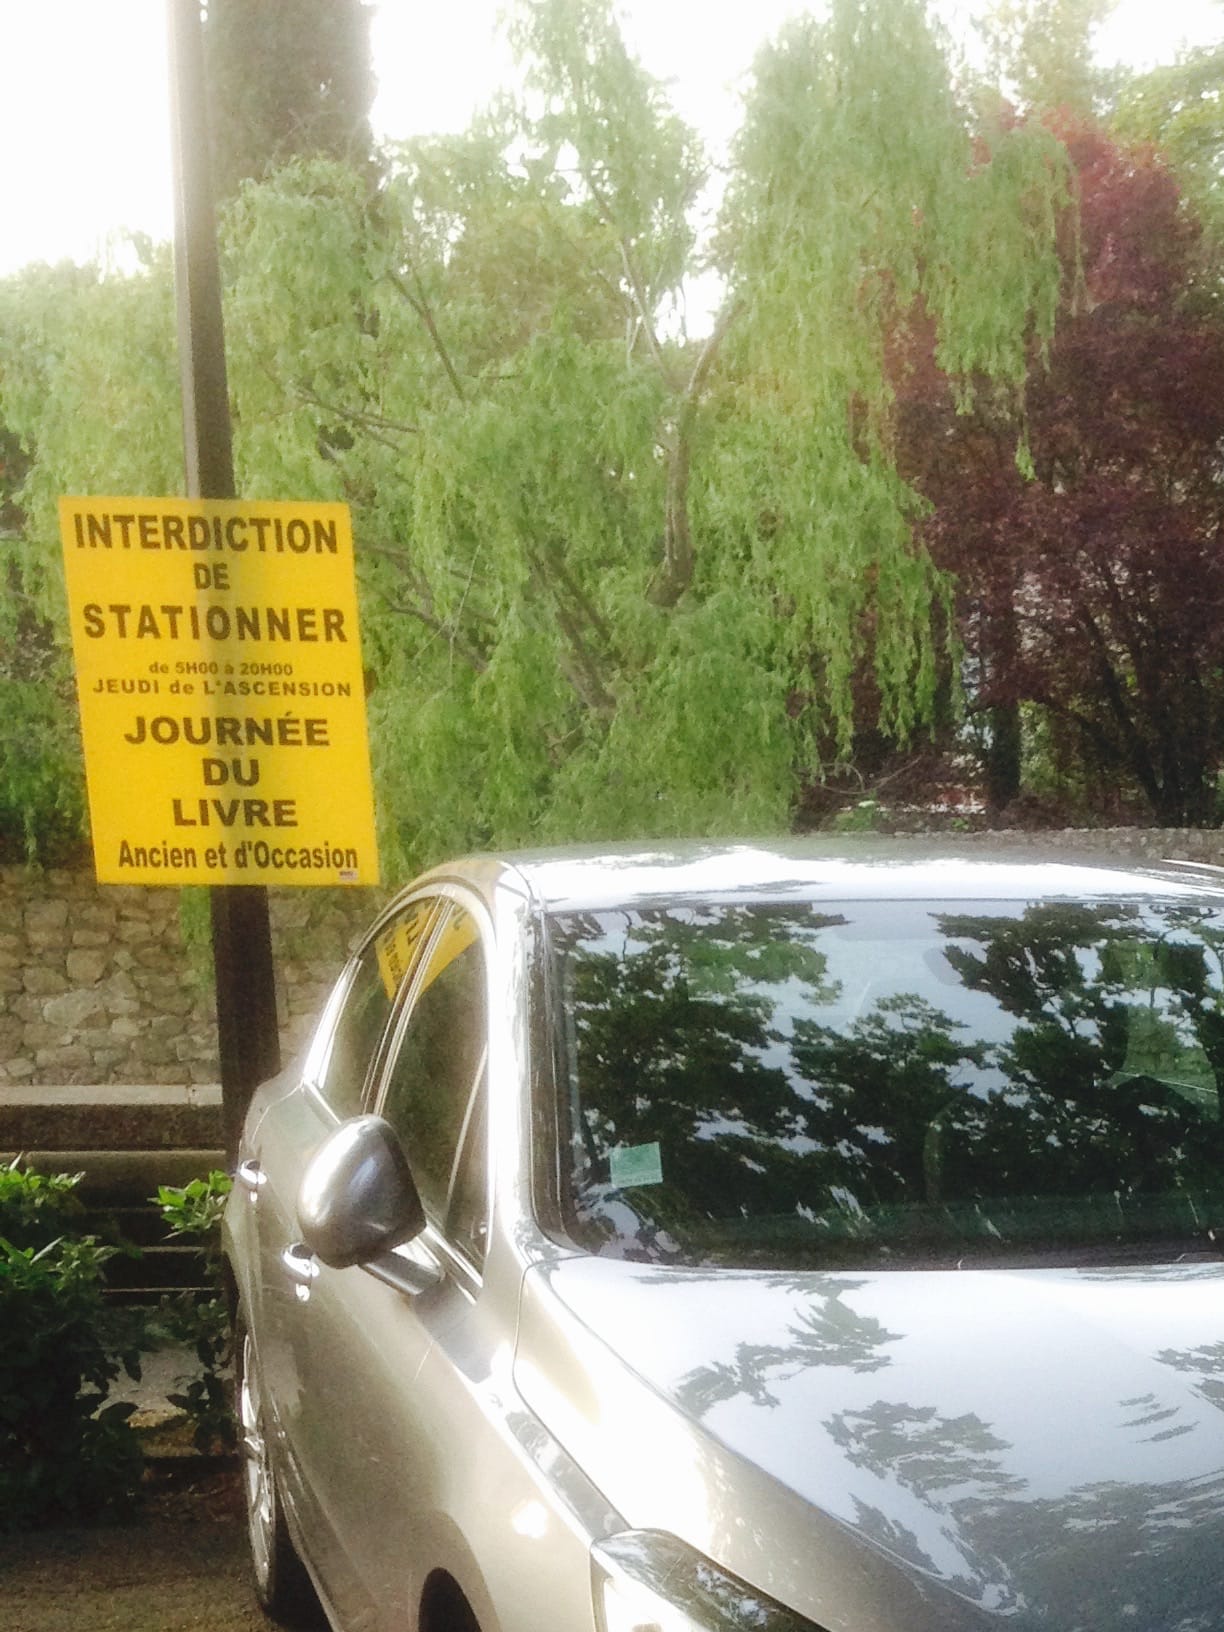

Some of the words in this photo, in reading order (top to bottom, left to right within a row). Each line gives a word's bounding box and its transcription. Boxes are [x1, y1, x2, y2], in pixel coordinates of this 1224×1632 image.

[74, 514, 338, 554] INTERDICTION
[193, 562, 230, 591] DE
[83, 603, 348, 643] STATIONNER
[149, 661, 169, 674] de
[240, 662, 294, 676] 20H00
[93, 679, 160, 694] JEUDI
[169, 680, 194, 695] de
[203, 680, 351, 697] L'ASCENSION
[124, 711, 330, 746] JOURNÉE
[201, 758, 260, 787] DU
[172, 798, 298, 827] LIVRE
[118, 840, 197, 868] Ancien
[205, 841, 228, 869] et
[234, 840, 358, 869] d'Occasion
